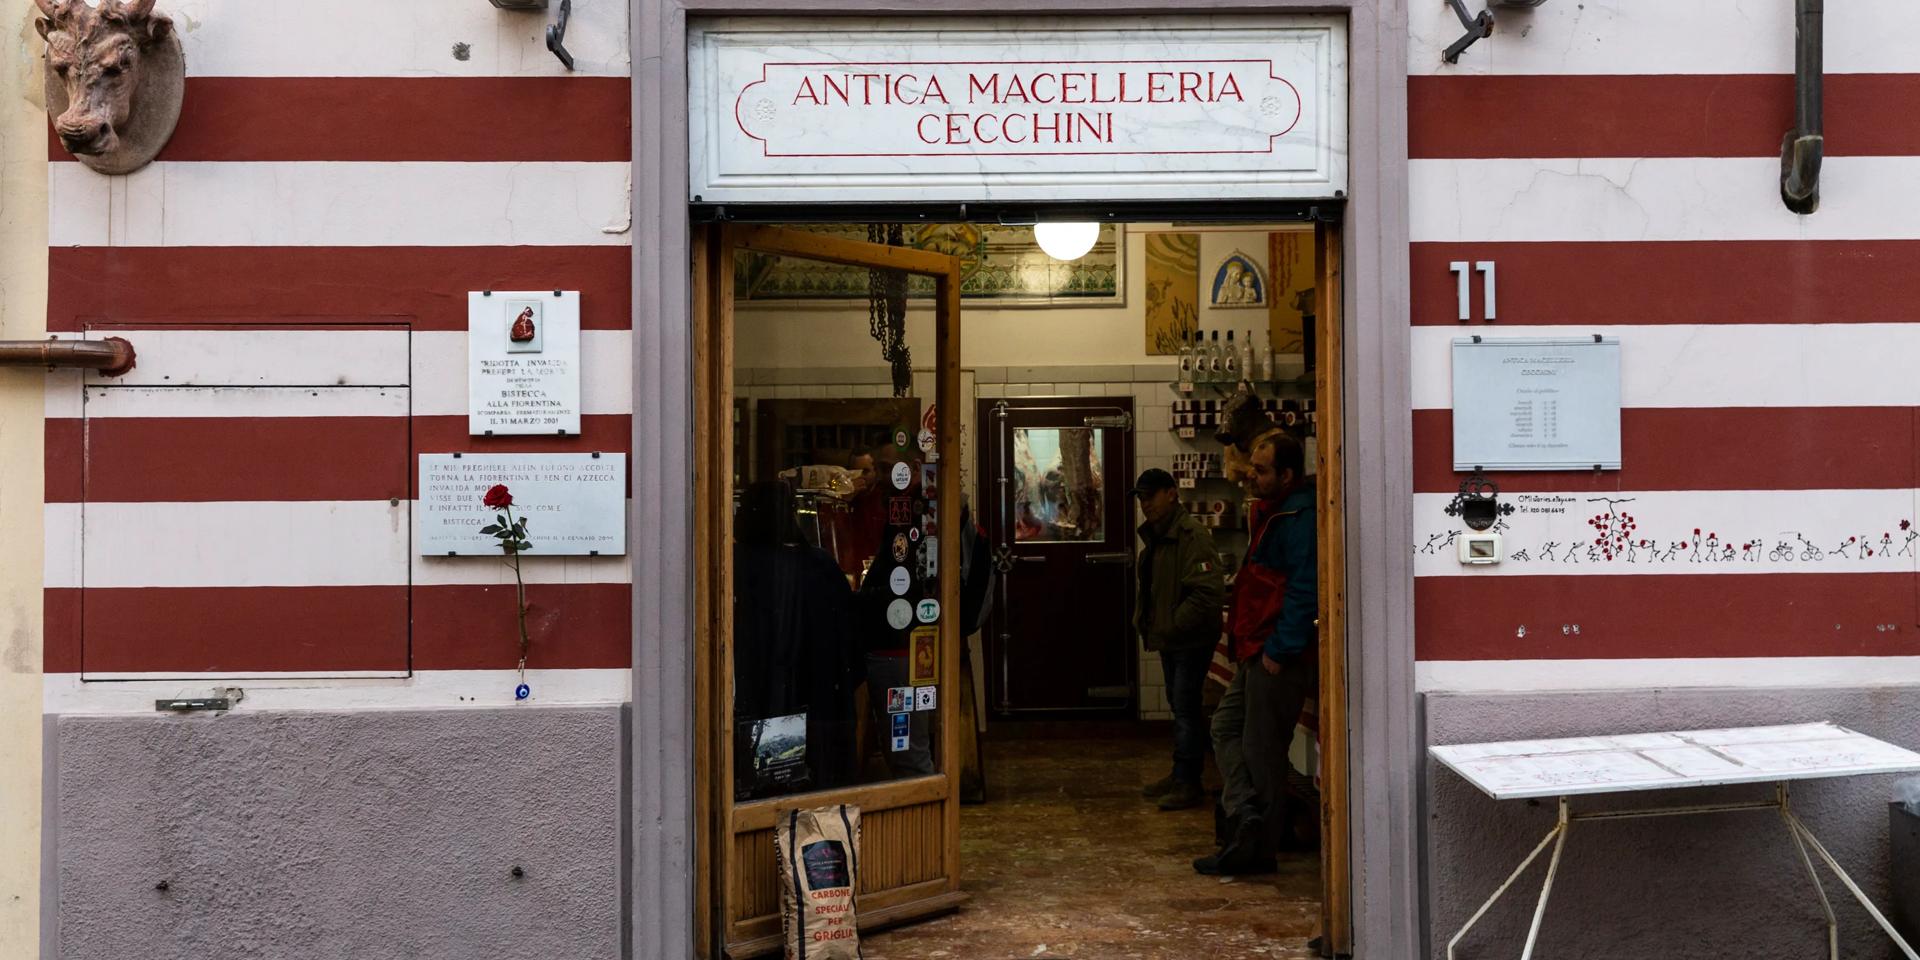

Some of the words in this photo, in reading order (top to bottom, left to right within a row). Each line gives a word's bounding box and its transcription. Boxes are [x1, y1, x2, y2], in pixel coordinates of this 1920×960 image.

[792, 73, 950, 106] ANTICA
[967, 71, 1245, 105] MACELLERIA
[916, 112, 1114, 145] CECCHINI
[1449, 260, 1497, 320] 11
[501, 390, 547, 398] BISTECCA
[487, 400, 509, 408] ALLA
[511, 400, 562, 408] FIORENTINA
[430, 474, 459, 482] TORNA
[464, 474, 475, 482] LA
[479, 474, 531, 482] FIORENTINA
[576, 474, 616, 482] AZZECCA
[429, 484, 470, 492] INVALIDA
[456, 494, 474, 502] DUE
[438, 504, 472, 512] INFATTI
[811, 888, 851, 900] CARBONE
[828, 917, 843, 926] PER
[813, 928, 854, 942] GRIGLIA
